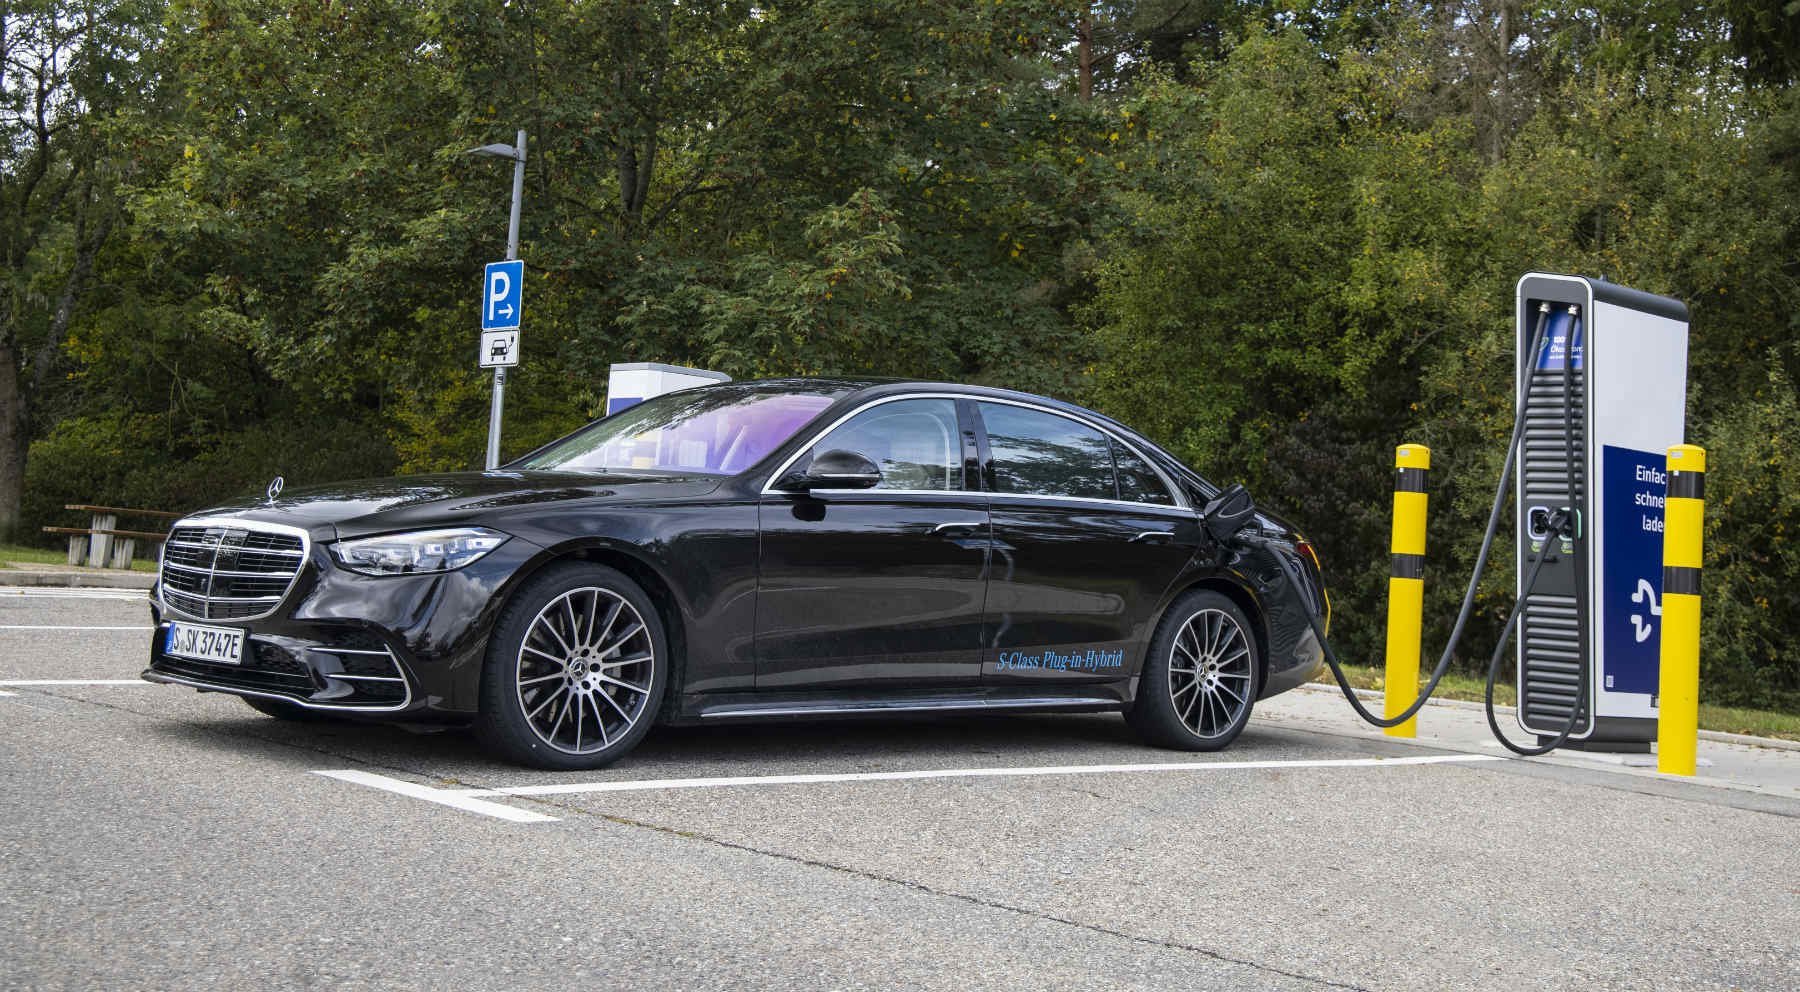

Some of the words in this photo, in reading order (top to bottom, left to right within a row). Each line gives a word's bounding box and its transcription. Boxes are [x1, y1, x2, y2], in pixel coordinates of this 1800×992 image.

[488, 271, 510, 321] P
[1634, 490, 1666, 509] schne
[996, 652, 1039, 670] S-Class
[1042, 650, 1123, 672] Plug-in-Hybrid
